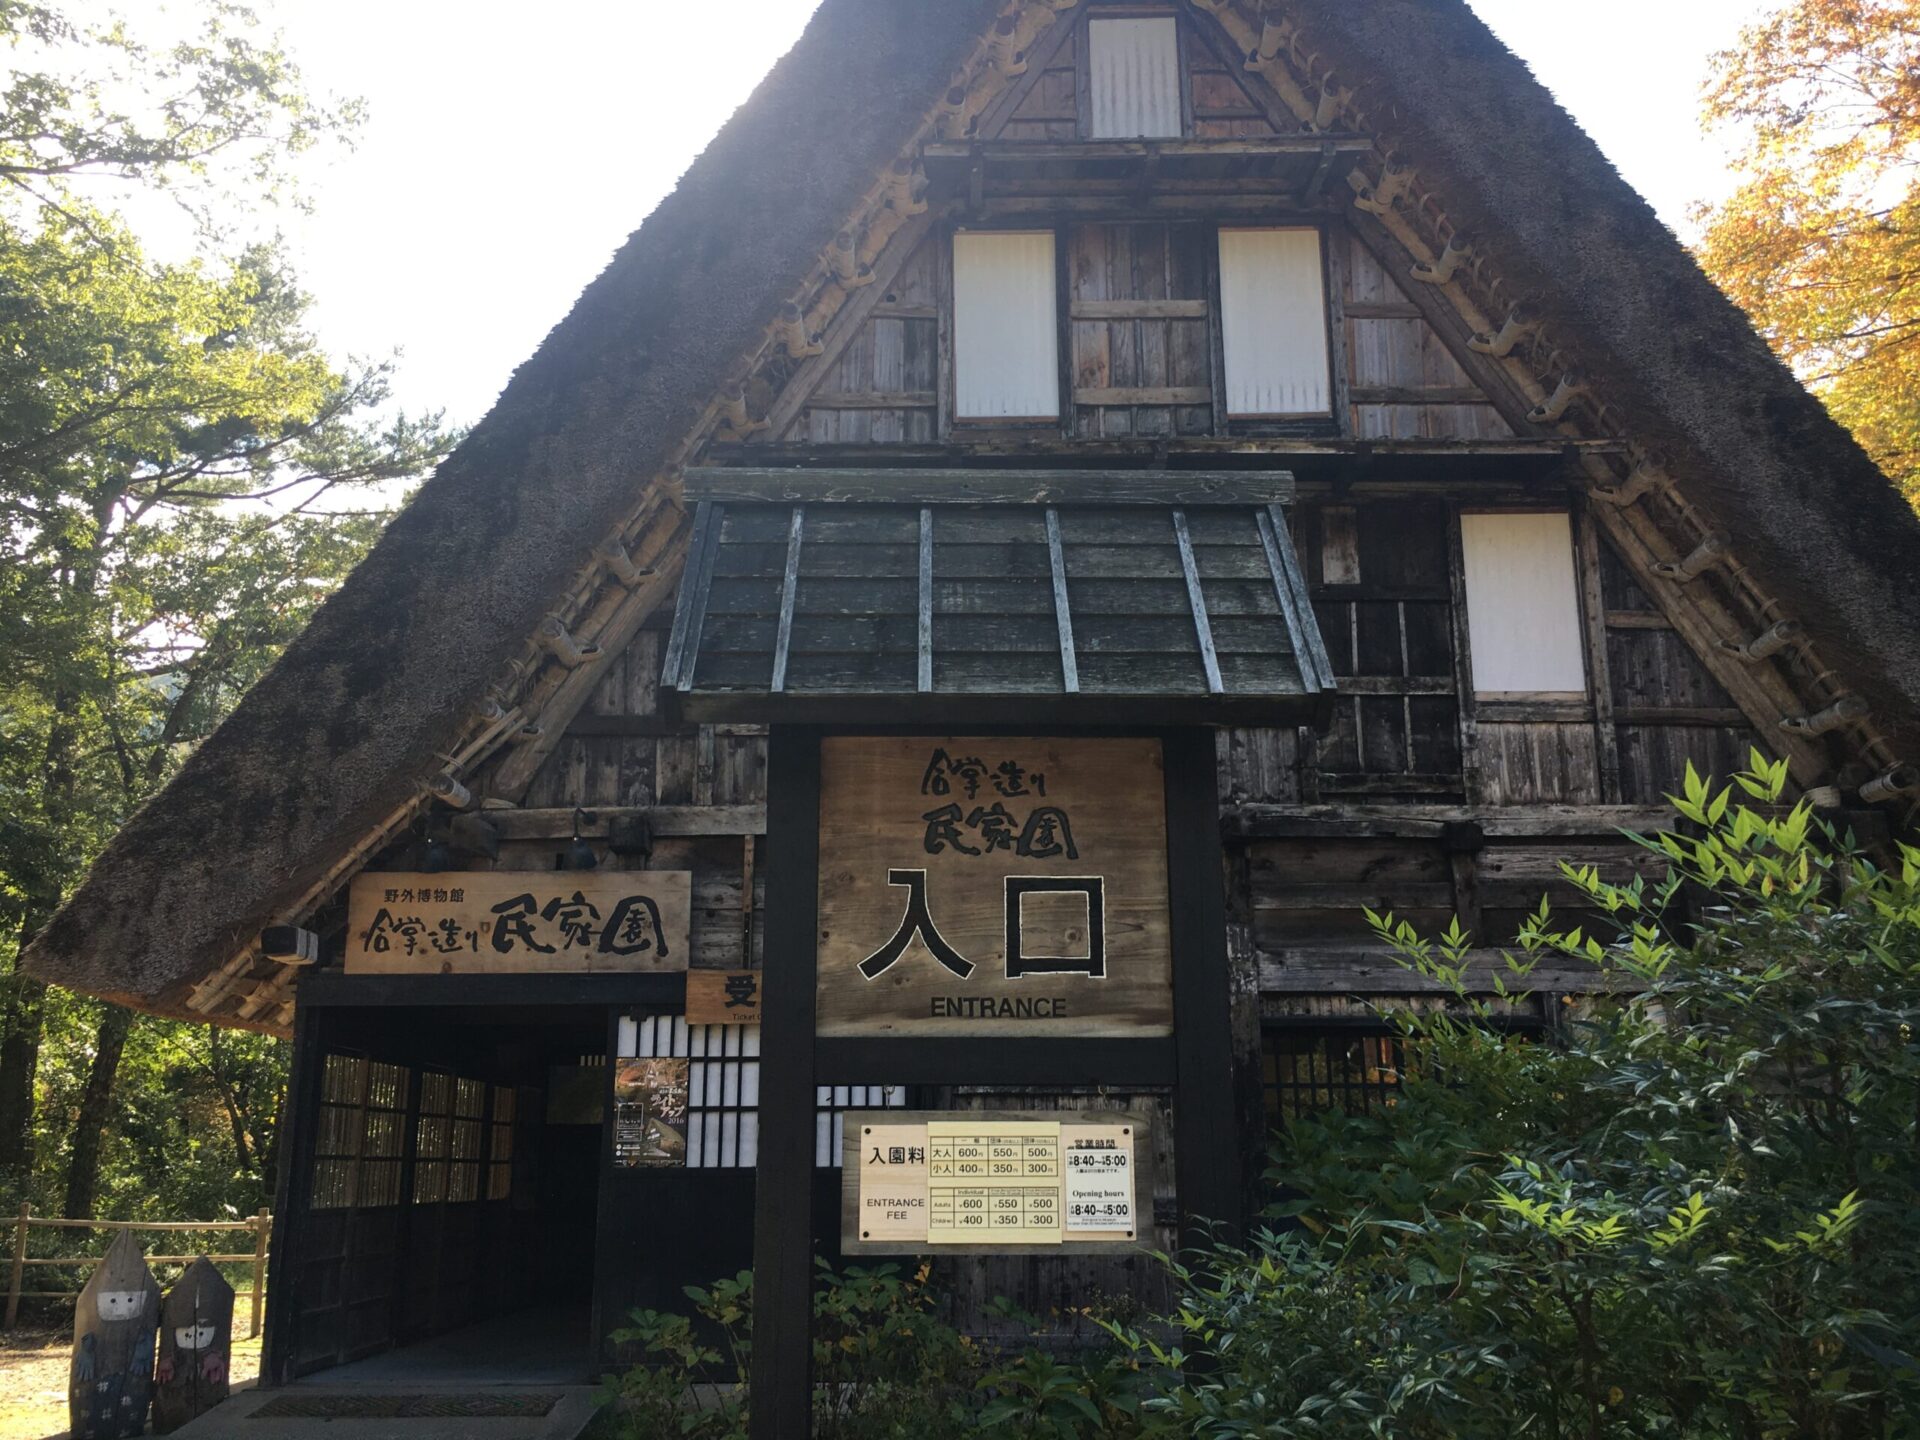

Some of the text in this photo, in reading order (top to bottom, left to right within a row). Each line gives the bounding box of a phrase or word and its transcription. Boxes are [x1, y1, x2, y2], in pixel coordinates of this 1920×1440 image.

[921, 748, 1046, 800] 合掌造り
[922, 802, 1080, 860] 民家園
[384, 888, 465, 903] 野外博物館
[363, 890, 670, 958] 合掌造り 民家園
[856, 868, 1107, 981] 入口
[725, 975, 756, 1008] 受
[931, 996, 1067, 1018] ENTRANCE
[733, 1013, 755, 1021] Ticket
[869, 1146, 925, 1165] 入園料
[933, 1148, 952, 1158] 大人
[933, 1164, 952, 1174] 小人
[1072, 1190, 1103, 1198] Opening
[867, 1198, 925, 1208] ENTRANCE
[887, 1211, 907, 1220] FEE
